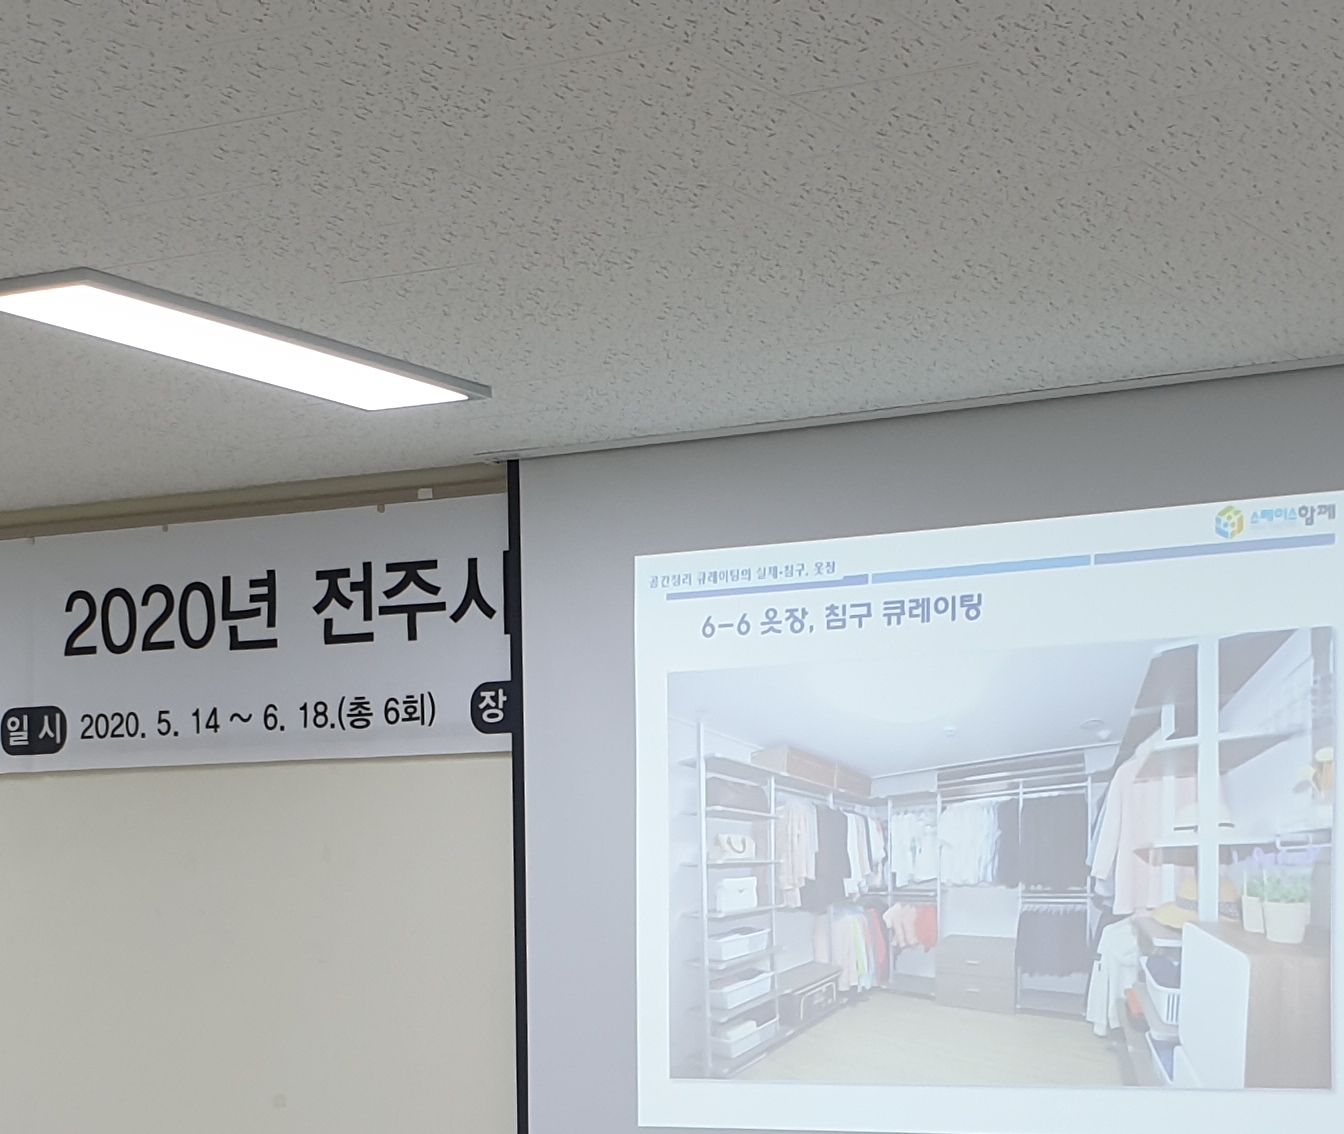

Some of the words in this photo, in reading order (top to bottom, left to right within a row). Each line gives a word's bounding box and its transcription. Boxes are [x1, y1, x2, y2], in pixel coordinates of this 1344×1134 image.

[64, 569, 278, 657] 2020년
[701, 612, 752, 639] 6-6
[760, 606, 815, 635] 옷장,
[824, 602, 873, 631] 침구
[882, 592, 984, 627] 큐레이팅
[80, 711, 146, 740] 2020.
[157, 710, 180, 737] 5.
[191, 706, 221, 734] 14
[262, 703, 286, 732] 6.
[383, 691, 436, 727] 6회)
